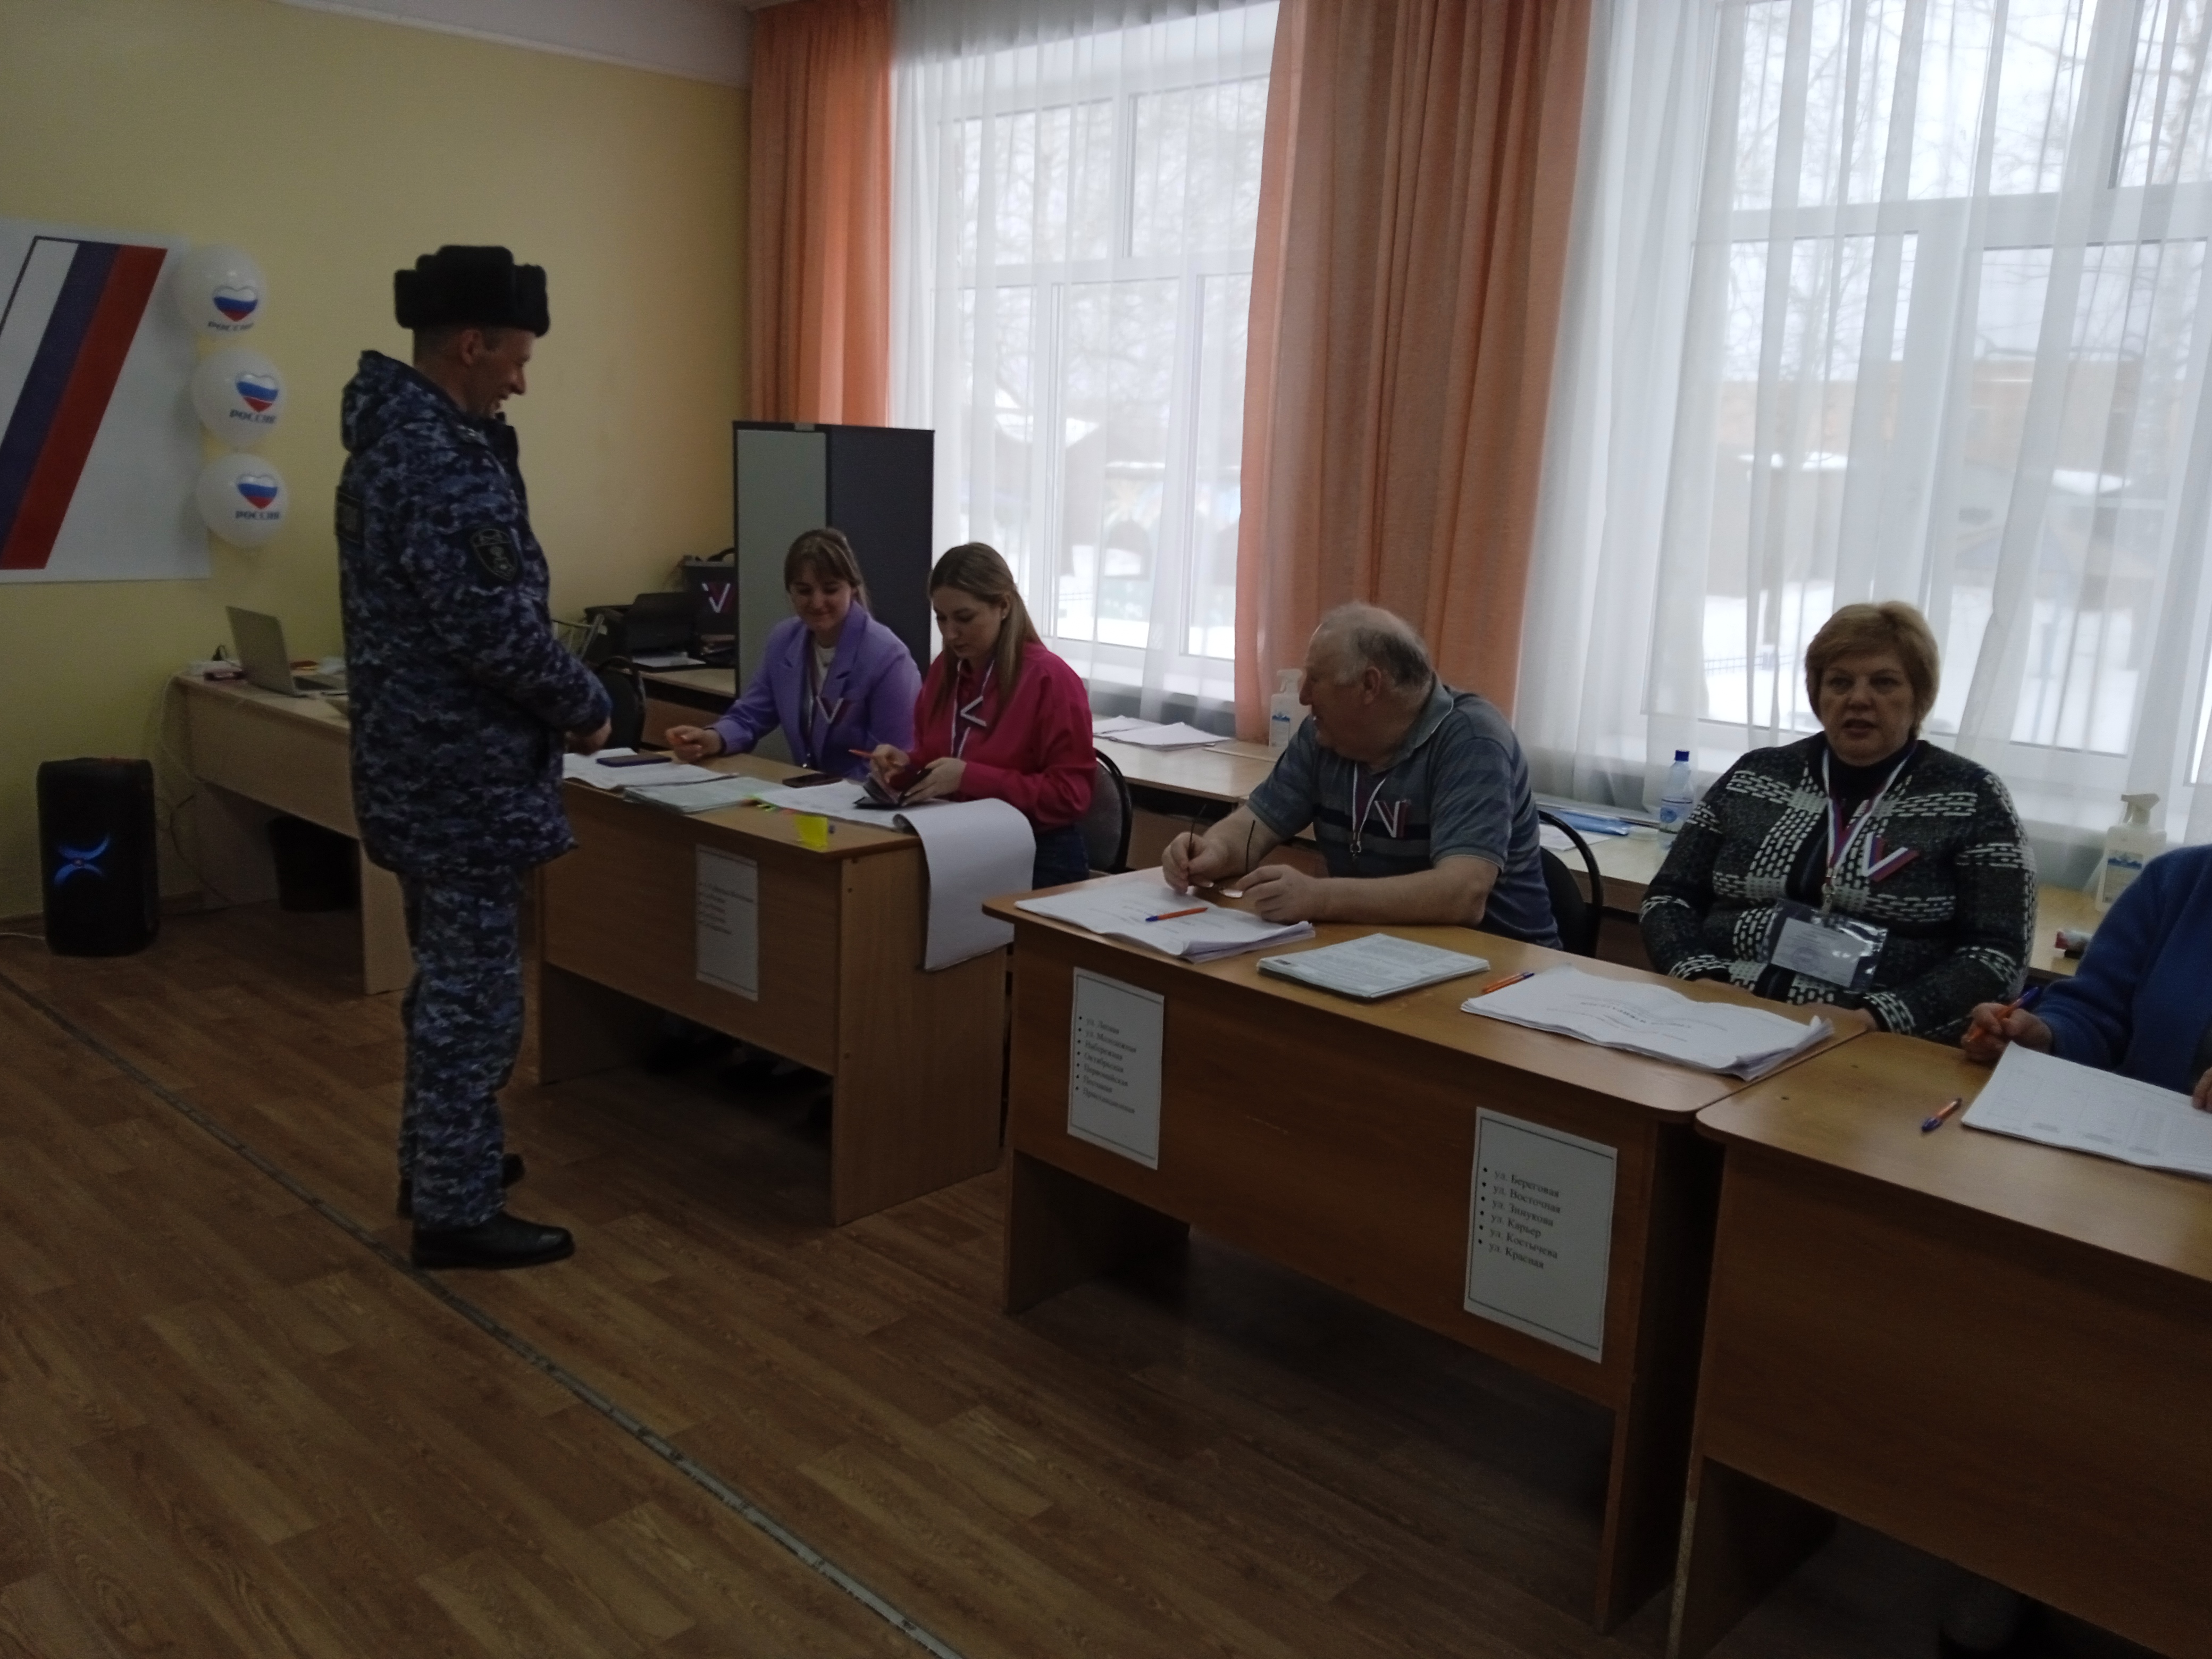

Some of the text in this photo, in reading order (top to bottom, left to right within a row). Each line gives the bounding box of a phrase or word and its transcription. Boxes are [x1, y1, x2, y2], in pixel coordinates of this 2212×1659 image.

[230, 409, 275, 423] РОССИЯ
[236, 511, 279, 520] РОССИЯ
[1495, 1171, 1559, 1197] ул. Береговая
[1493, 1186, 1560, 1213] ул. Восточная
[1493, 1201, 1505, 1210] ул.
[1492, 1215, 1540, 1237] ул. Карьер
[1490, 1229, 1557, 1258] ул. Костычева
[1489, 1244, 1543, 1268] ул. Красная
